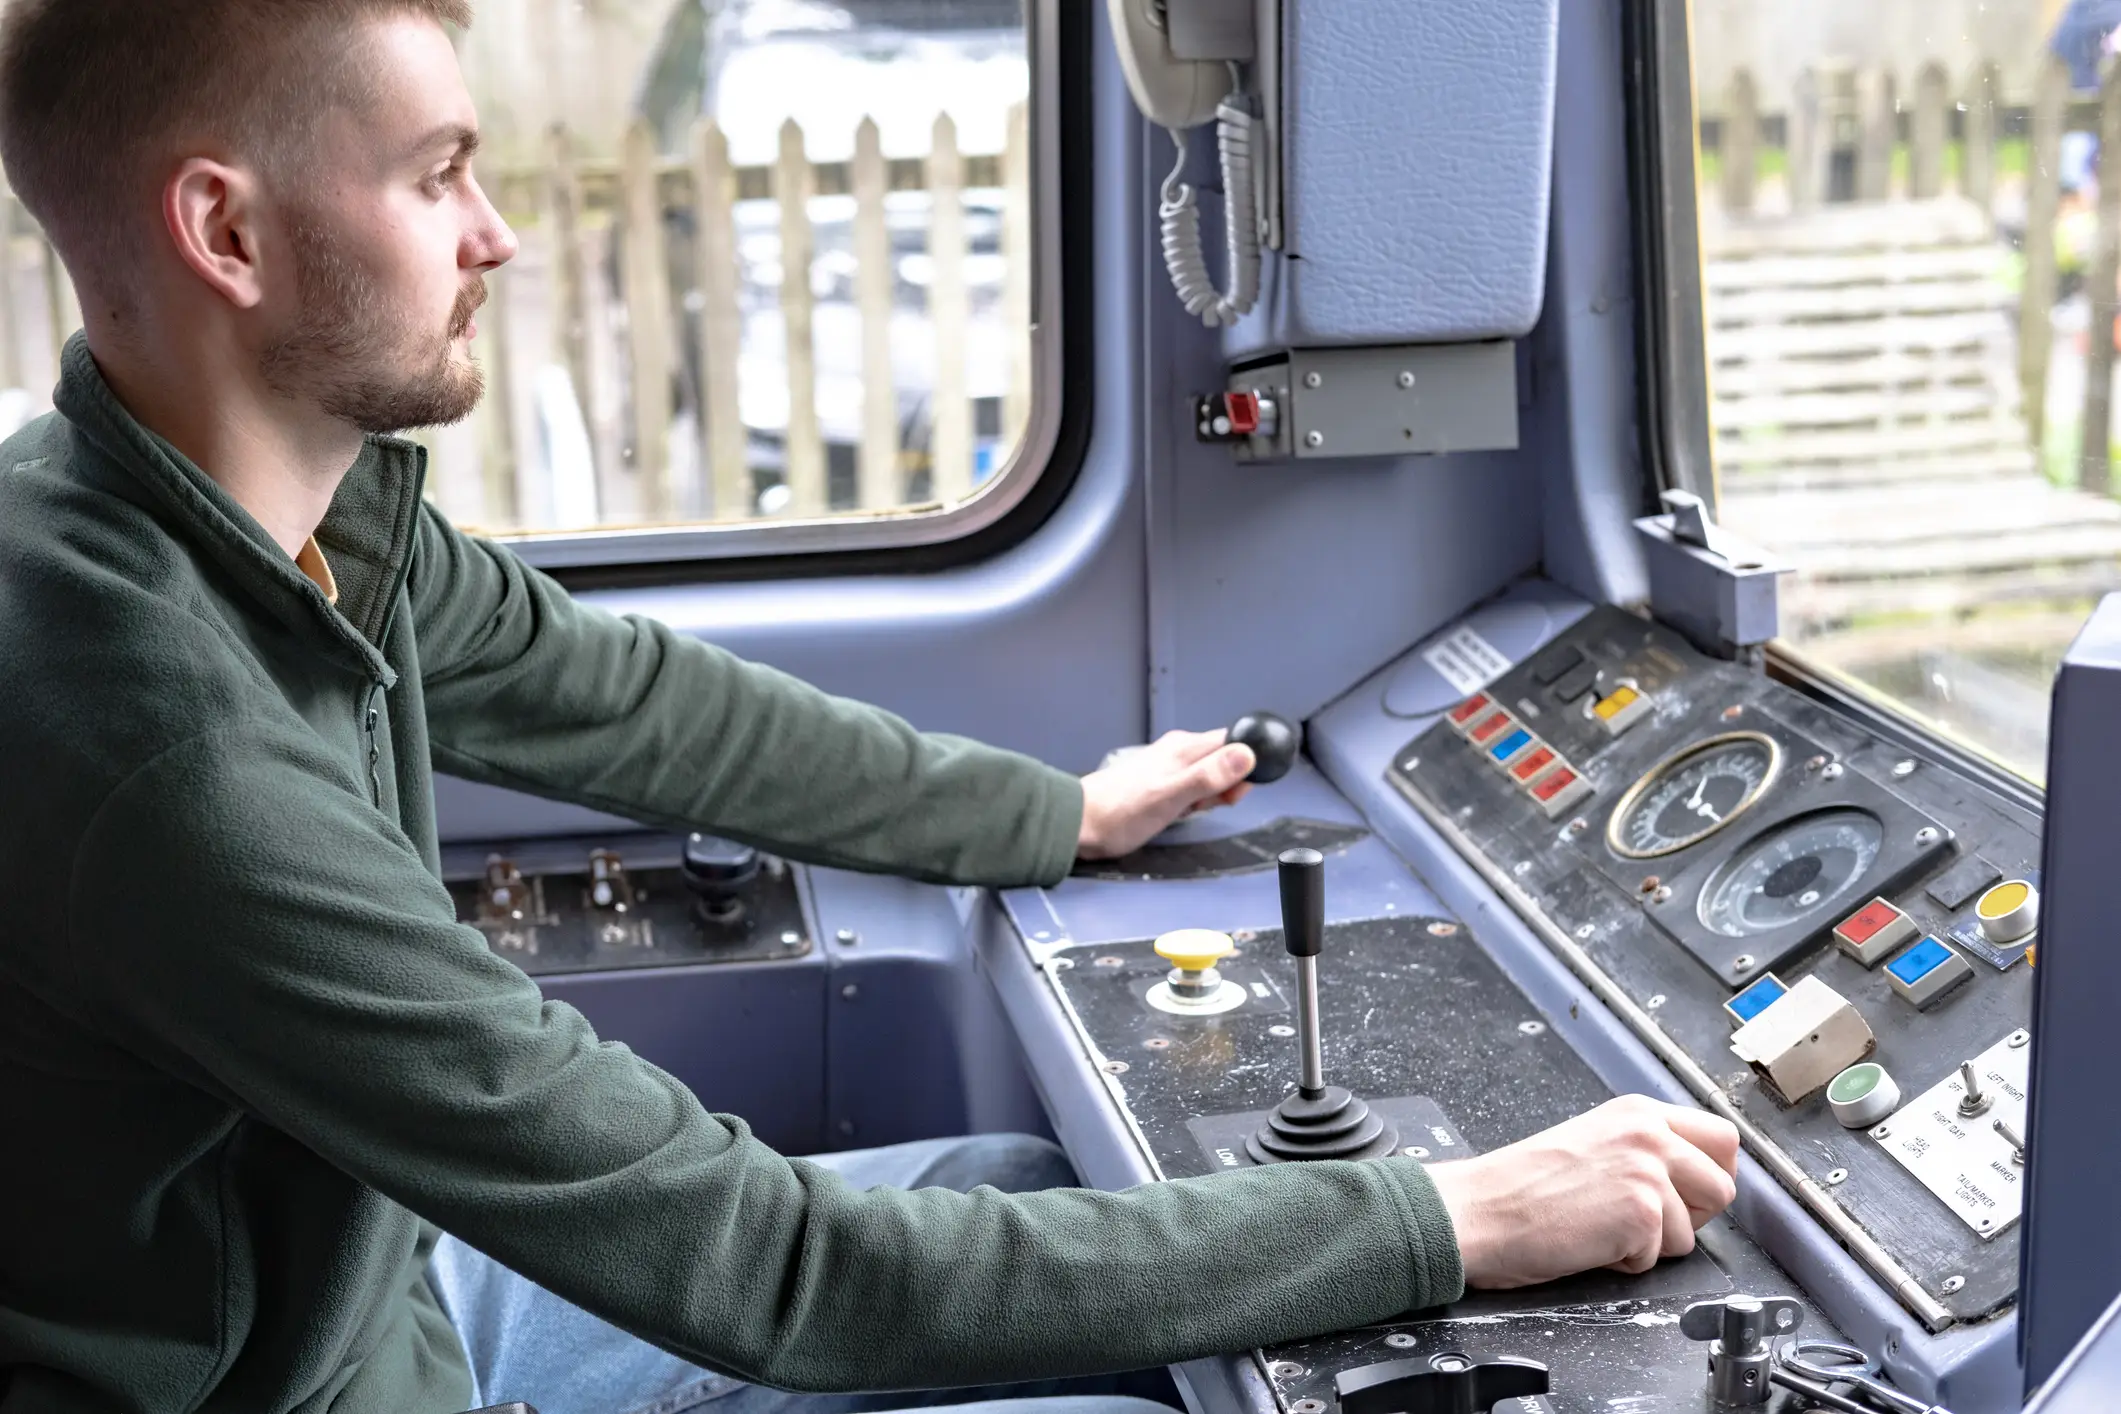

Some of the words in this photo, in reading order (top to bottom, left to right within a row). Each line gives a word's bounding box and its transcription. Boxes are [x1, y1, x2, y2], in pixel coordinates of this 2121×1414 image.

[1986, 1071, 2005, 1084] LEFT
[1948, 1082, 1963, 1092] OFF
[1932, 1110, 1952, 1127] RIGHT
[1430, 1126, 1455, 1147] HIGH
[1914, 1136, 1931, 1151] HEAD
[1215, 1148, 1239, 1166] LOW
[1902, 1140, 1924, 1158] LIGHTS
[1989, 1160, 2017, 1184] MARKER
[1955, 1187, 1978, 1208] LIGHTS
[1956, 1173, 1996, 1209] TAIL/MARKER
